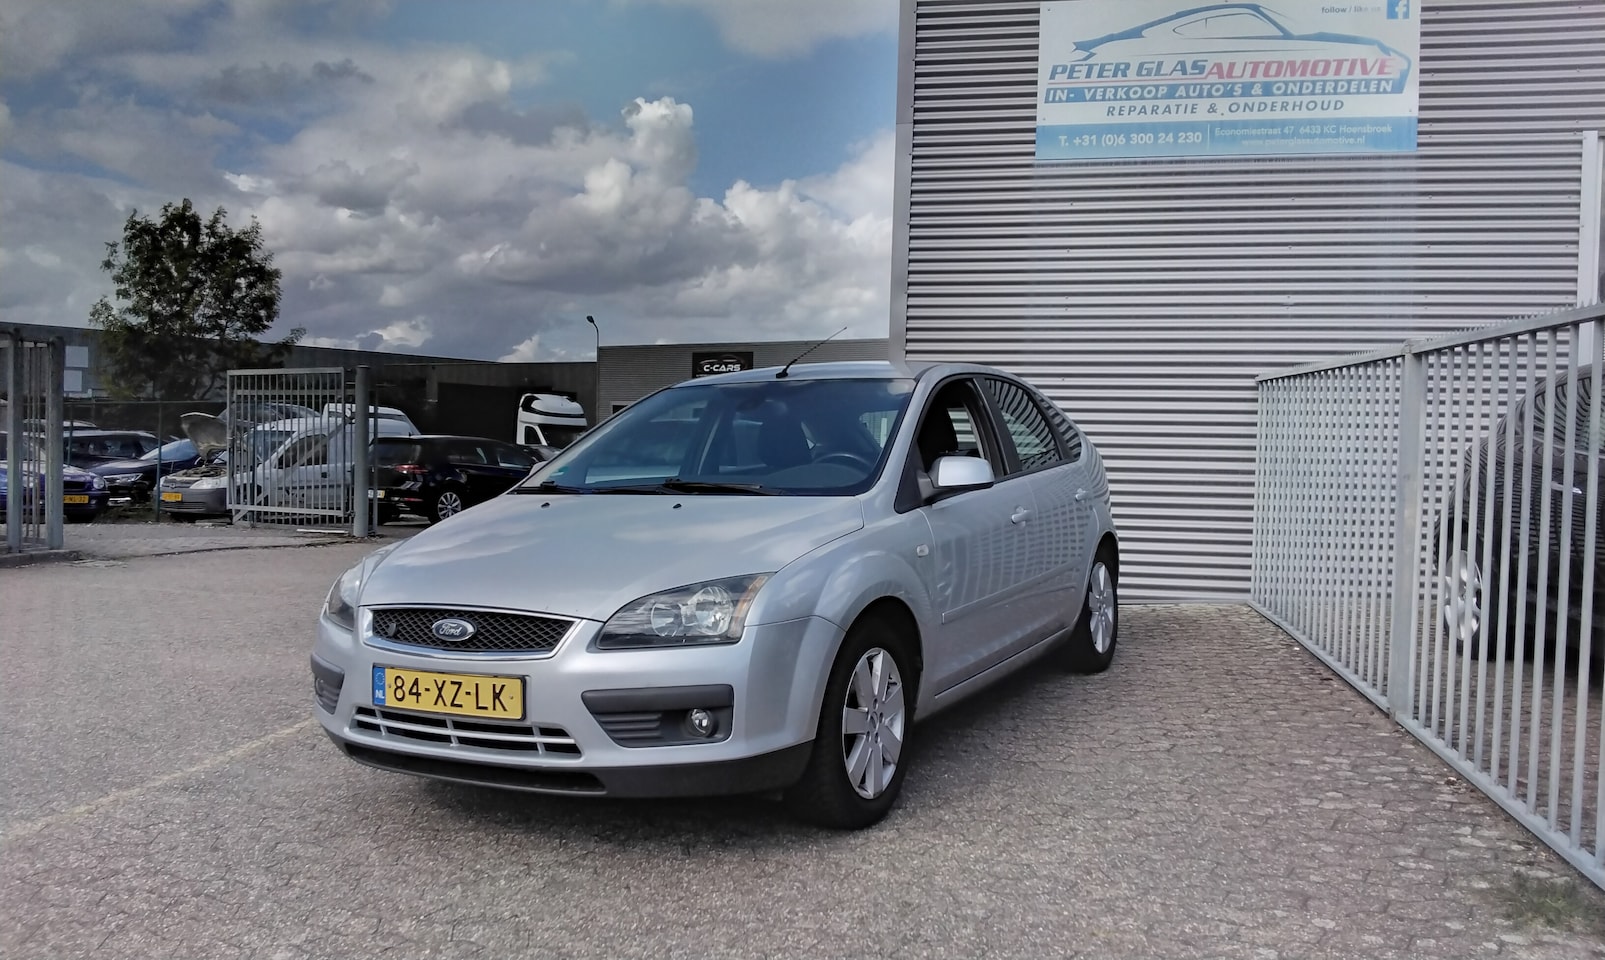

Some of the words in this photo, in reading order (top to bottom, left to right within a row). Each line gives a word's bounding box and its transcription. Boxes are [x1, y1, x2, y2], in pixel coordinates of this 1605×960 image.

[1048, 62, 1131, 80] PETER
[1048, 89, 1075, 102] IN-
[1084, 85, 1168, 101] VERKOOP
[1175, 83, 1242, 97] AUTO'S
[1251, 83, 1263, 95] &
[1272, 80, 1393, 95] ONDERDELEN
[1106, 103, 1199, 116] REPARATIE
[1207, 102, 1218, 114] &
[1228, 99, 1344, 113] ONDERHOUD
[1215, 126, 1281, 136] Economiestraat
[1283, 126, 1294, 134] 47
[1299, 125, 1321, 134] 6433
[1324, 125, 1337, 134] KC
[1340, 124, 1392, 133] Hoensbroek
[1059, 135, 1069, 146] T.
[1073, 134, 1097, 146] +31
[1101, 133, 1126, 147] (0)6
[1130, 133, 1154, 145] 300
[1158, 132, 1174, 144] 24
[1178, 131, 1202, 143] 230
[703, 364, 741, 372] C-CARS
[438, 622, 463, 636] Ford
[375, 690, 385, 699] NL
[393, 675, 508, 712] 84-XZ-LK
